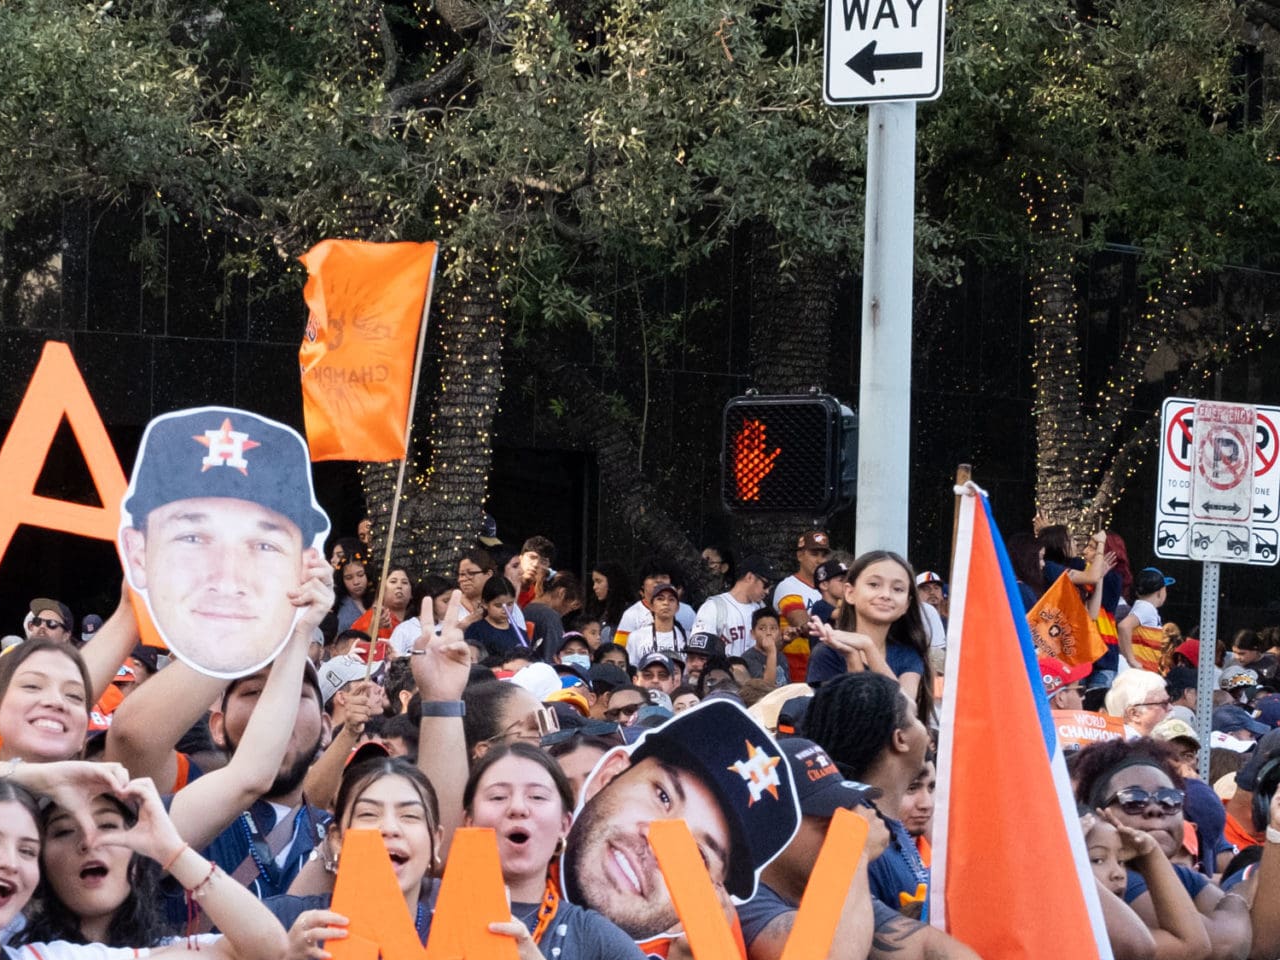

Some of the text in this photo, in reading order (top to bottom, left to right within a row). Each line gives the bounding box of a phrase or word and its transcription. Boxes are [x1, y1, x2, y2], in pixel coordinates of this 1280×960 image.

[842, 0, 923, 31] WAY
[1074, 712, 1107, 728] WORLD
[1058, 725, 1122, 742] CHAMPIO
